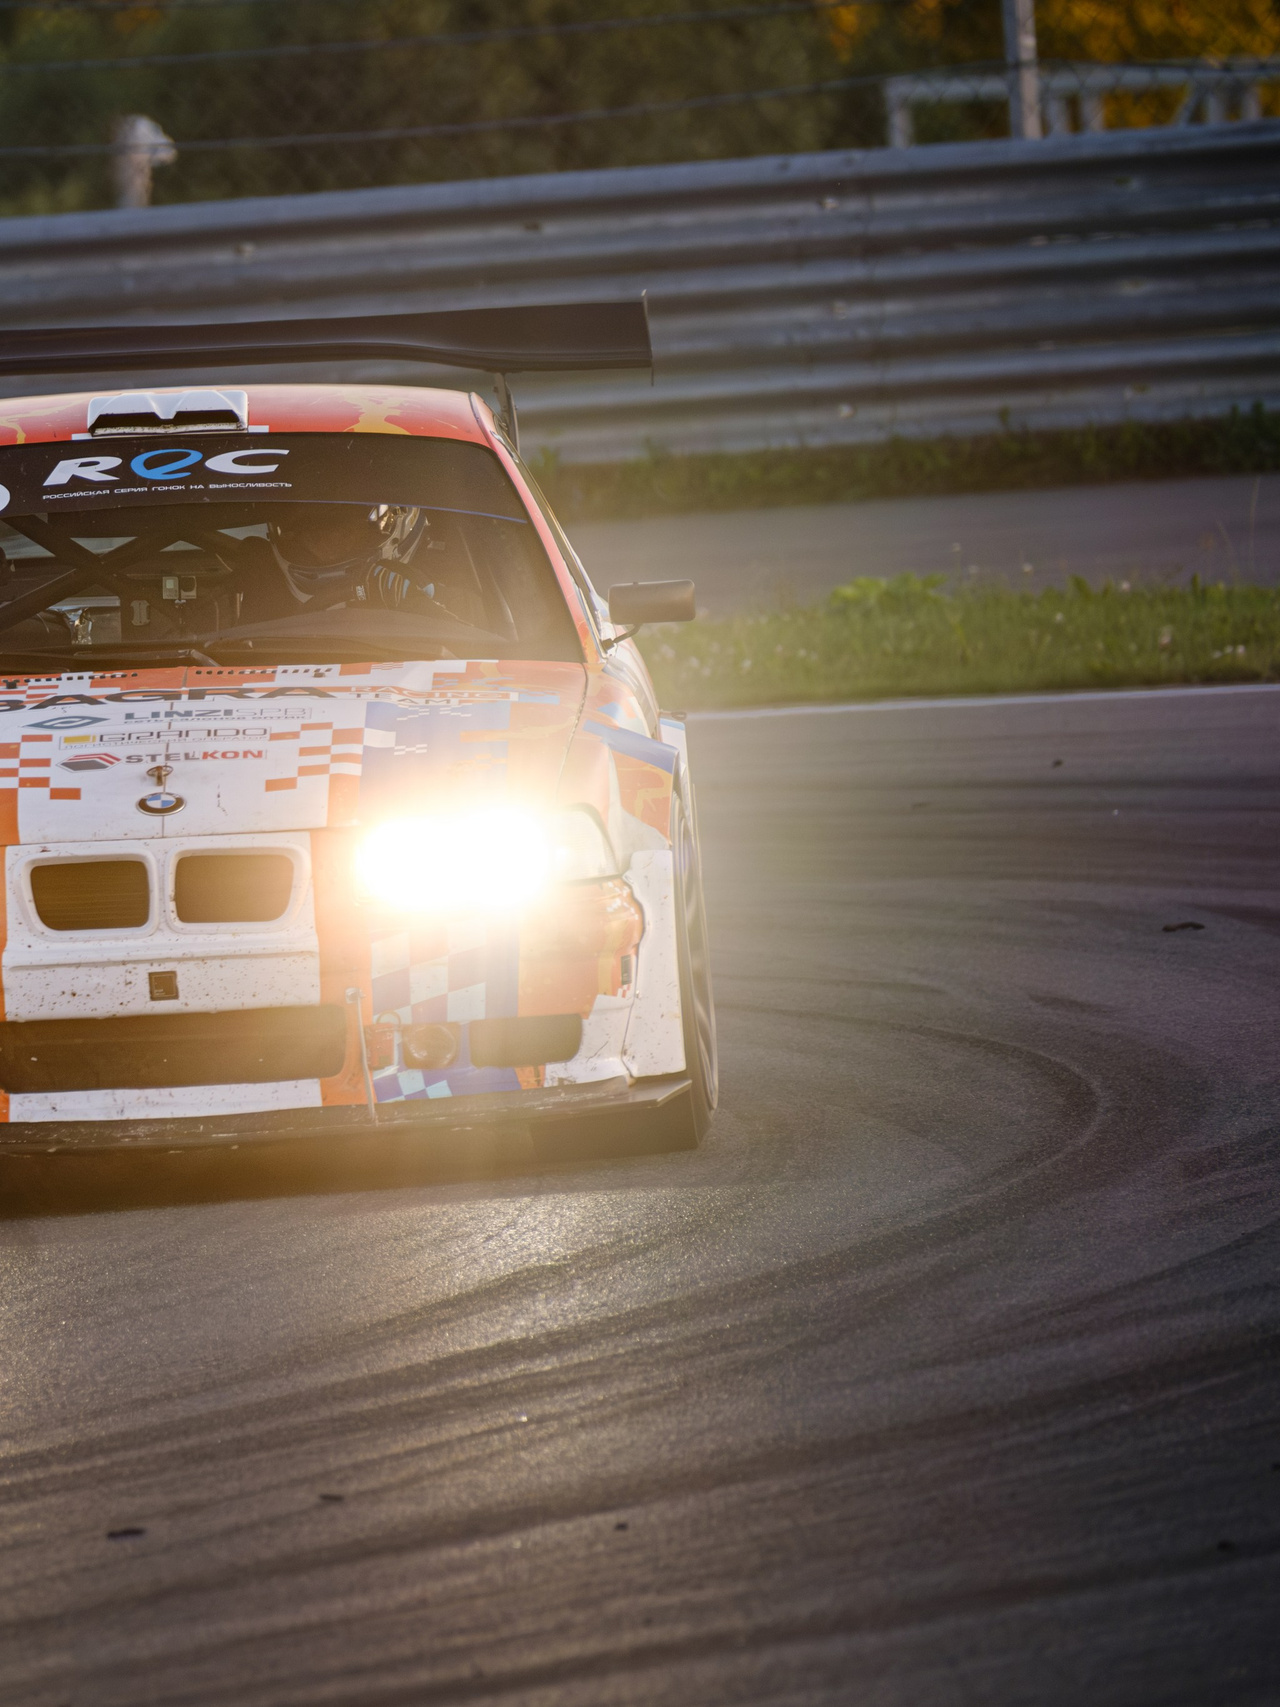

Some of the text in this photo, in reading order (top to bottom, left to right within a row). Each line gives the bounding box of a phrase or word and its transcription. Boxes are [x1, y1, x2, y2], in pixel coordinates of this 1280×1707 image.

[42, 488, 110, 500] РОССИЙСКАЯ
[114, 486, 148, 494] СЕРИЯ
[151, 484, 186, 492] ГОНОК
[208, 481, 292, 489] ВЫНОСЛИВОСТЬ
[350, 686, 503, 700] RACING
[350, 692, 451, 705] TEAM
[125, 750, 263, 764] STELKON
